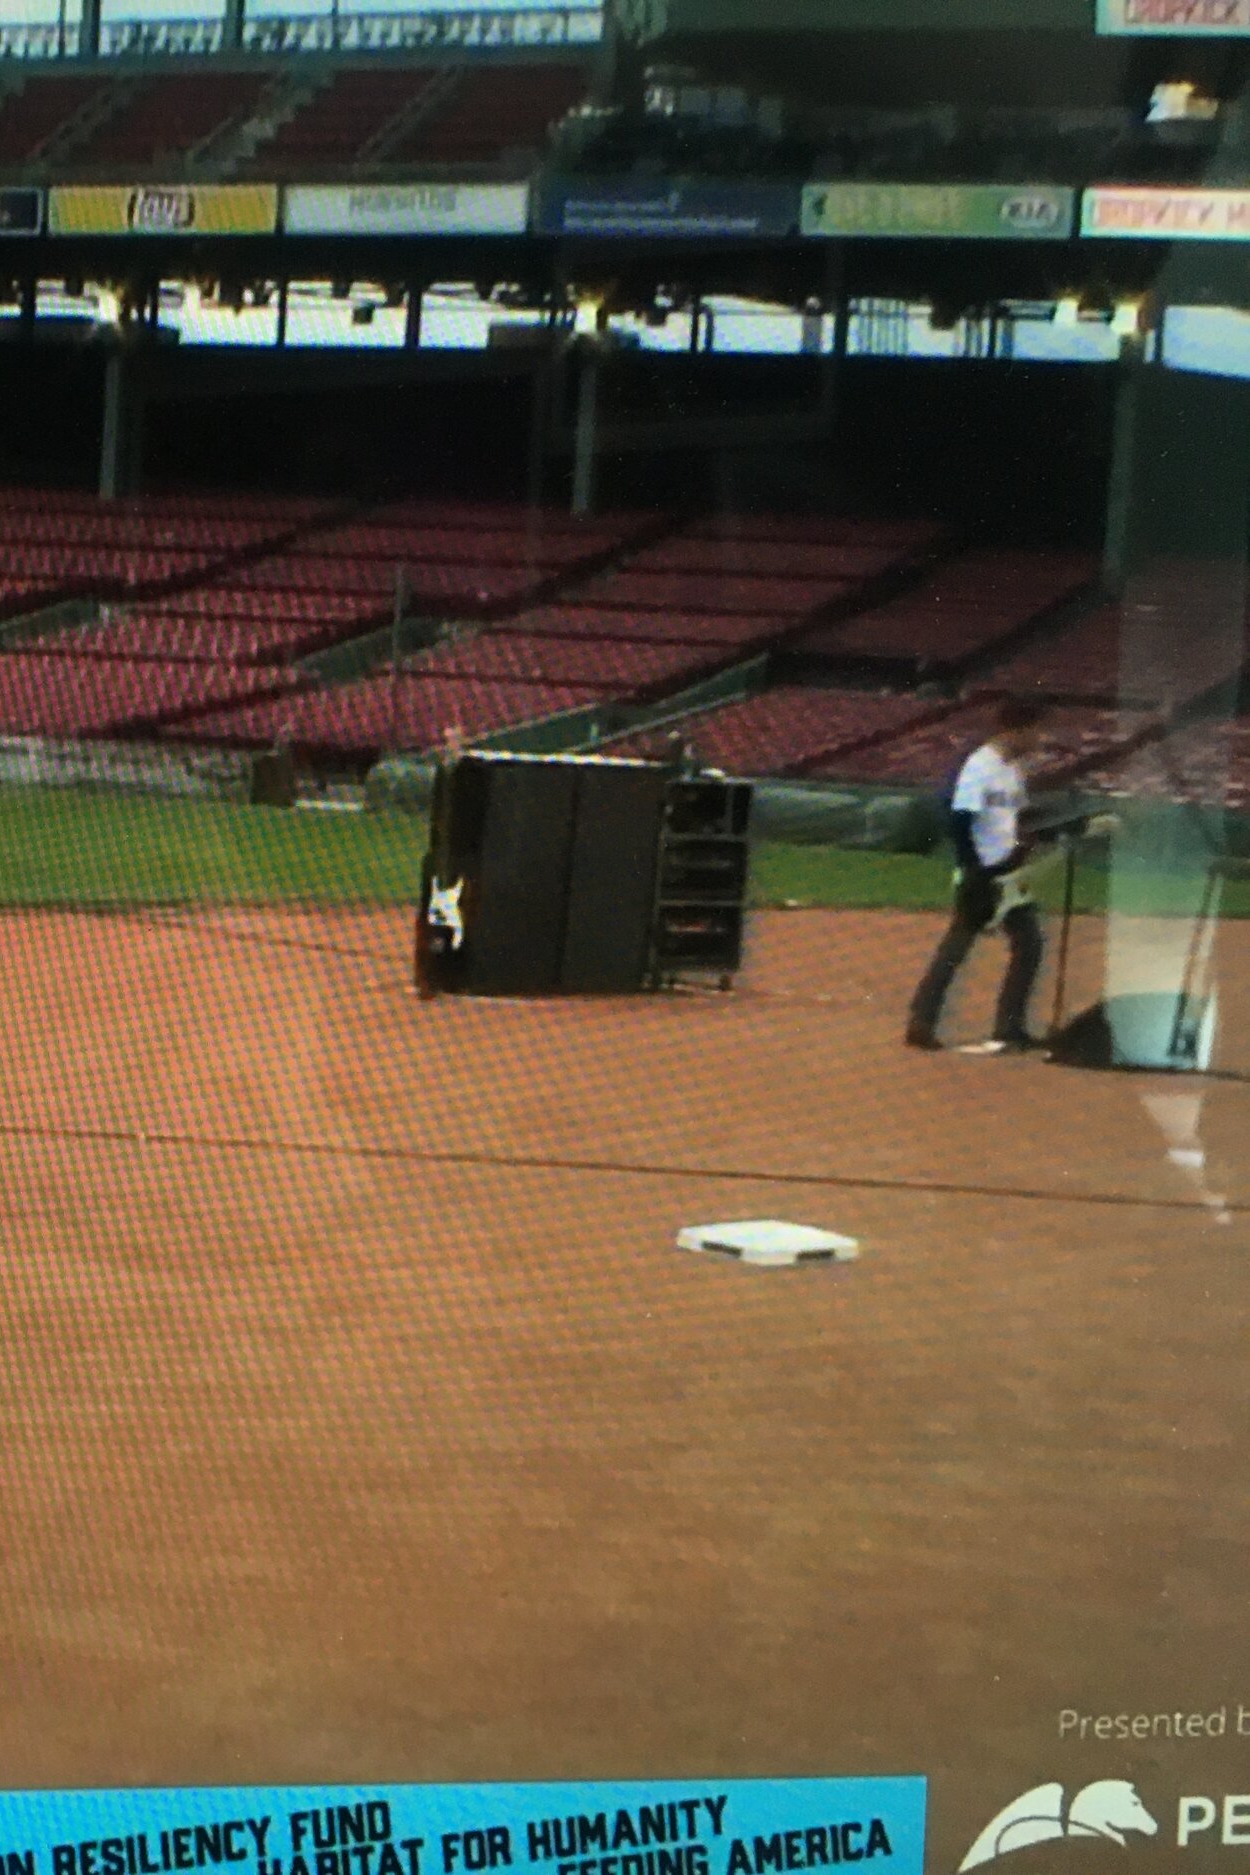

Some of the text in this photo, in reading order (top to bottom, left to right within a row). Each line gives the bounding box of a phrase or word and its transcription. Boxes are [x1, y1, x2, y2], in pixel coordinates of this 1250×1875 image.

[1060, 1705, 1227, 1740] Presented
[52, 1815, 271, 1875] RESILIENCY
[289, 1800, 391, 1850] FUND
[441, 1826, 512, 1873] FOR
[527, 1795, 728, 1862] HUMANITY
[727, 1818, 893, 1875] AMERICA
